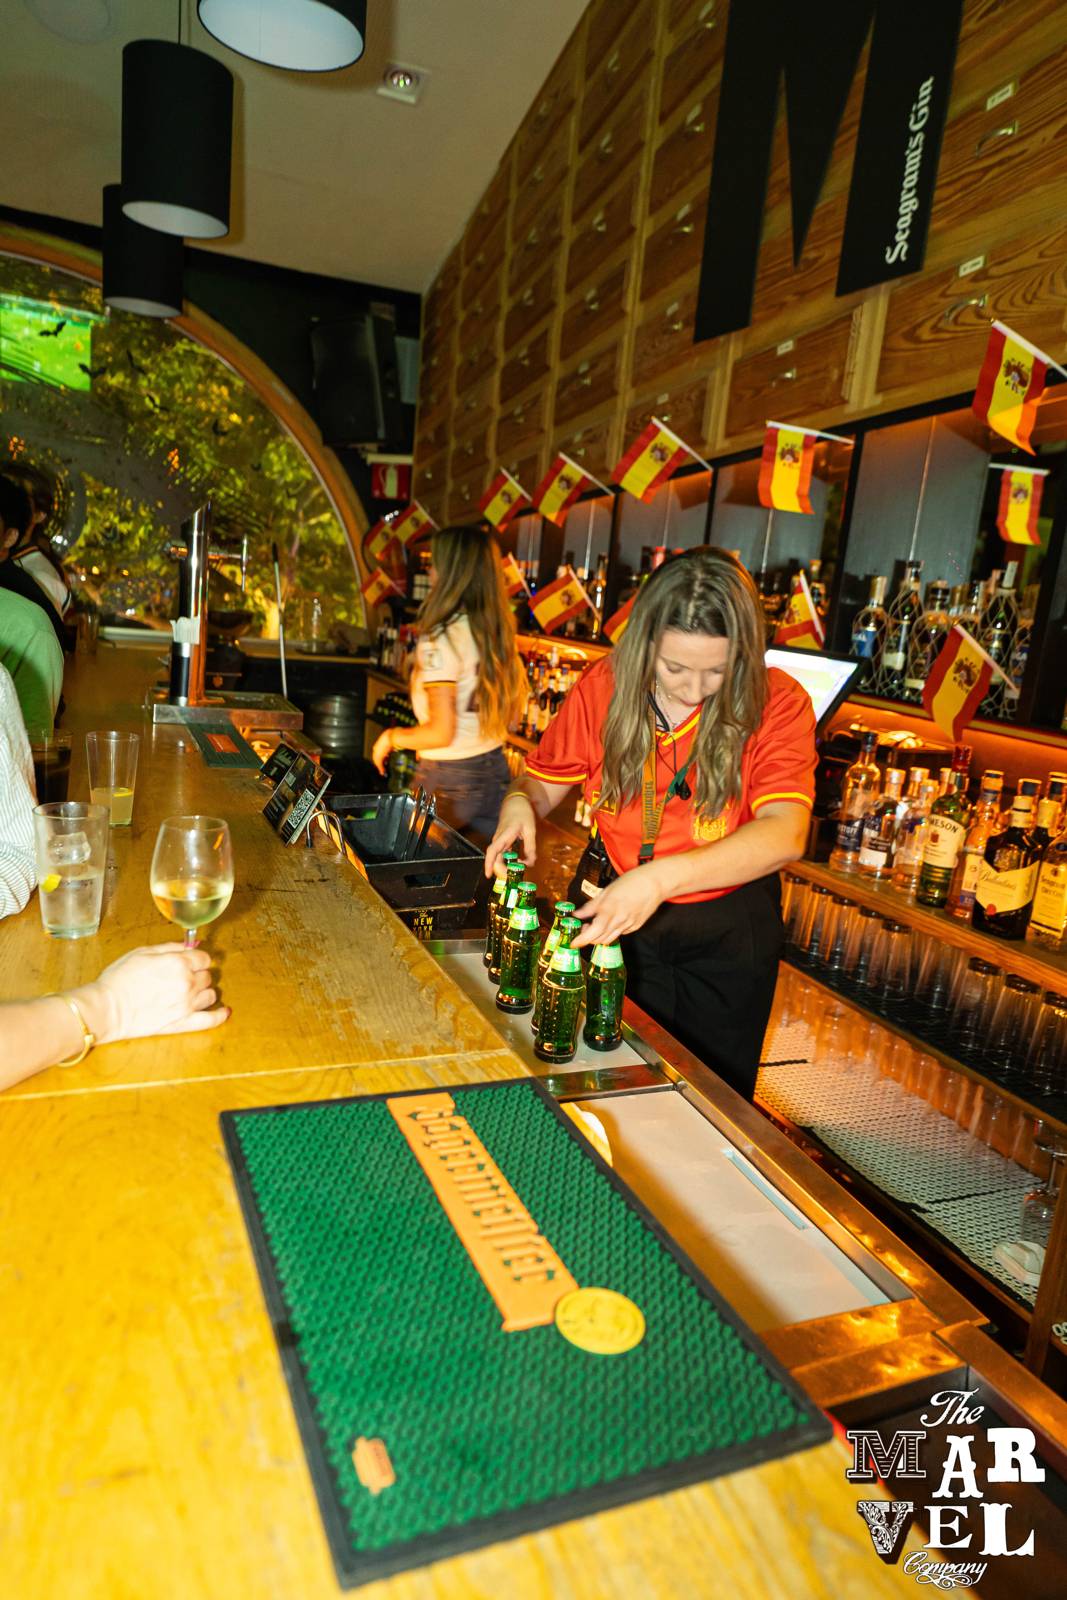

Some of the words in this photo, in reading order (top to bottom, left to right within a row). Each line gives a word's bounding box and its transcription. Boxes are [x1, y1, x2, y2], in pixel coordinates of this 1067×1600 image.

[885, 131, 925, 264] Seagram's
[909, 75, 934, 132] Gin
[413, 916, 433, 926] NEW
